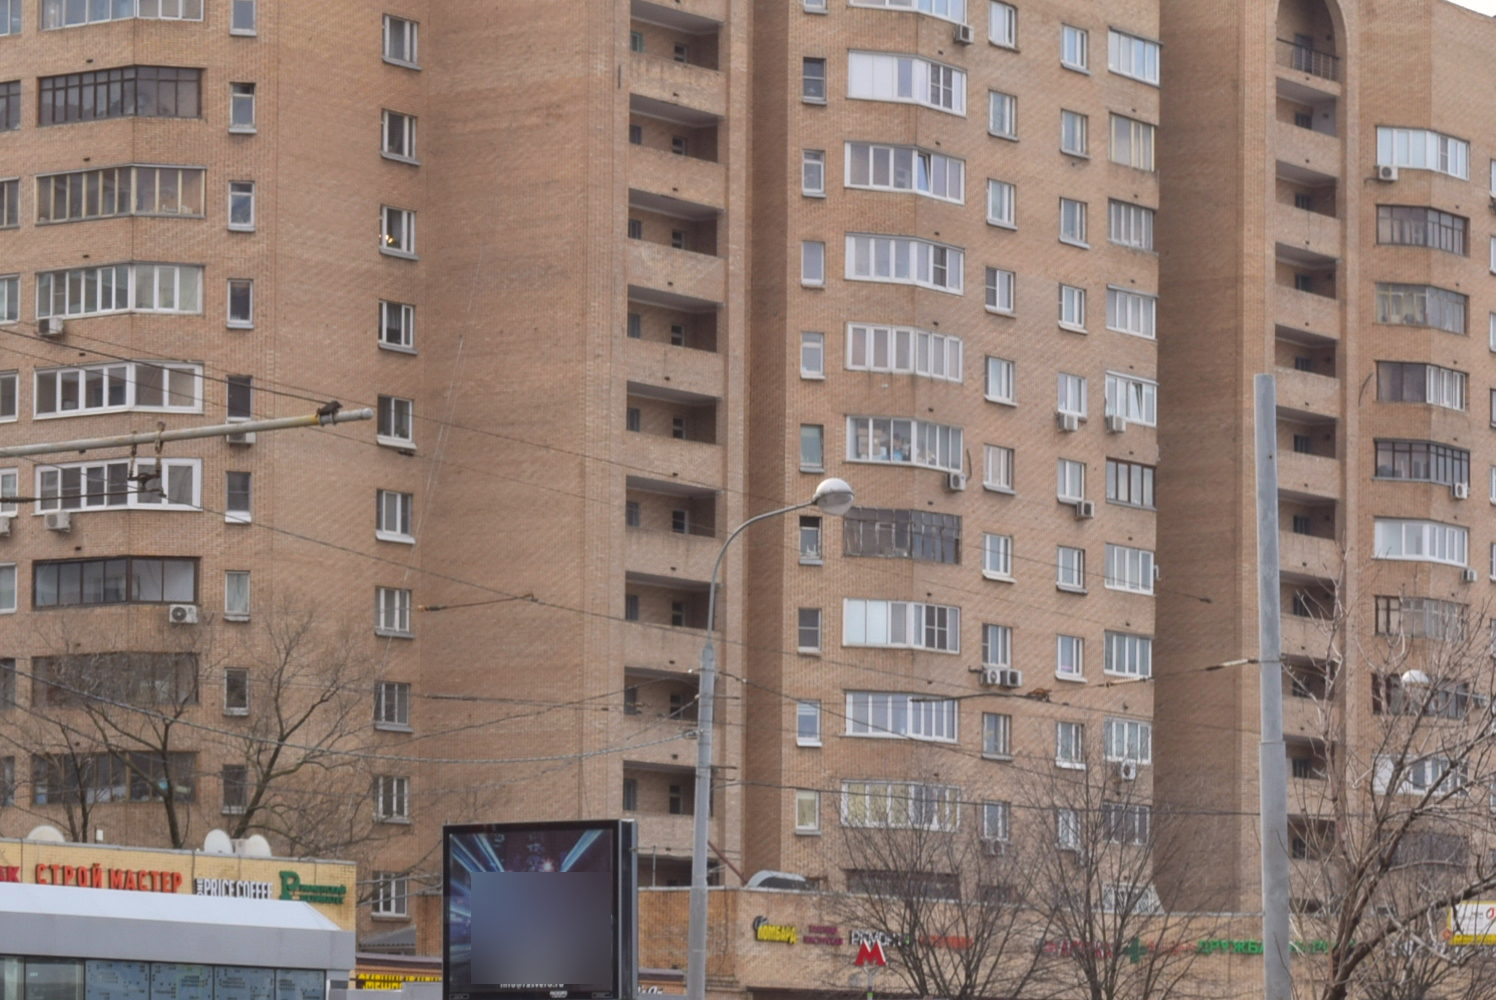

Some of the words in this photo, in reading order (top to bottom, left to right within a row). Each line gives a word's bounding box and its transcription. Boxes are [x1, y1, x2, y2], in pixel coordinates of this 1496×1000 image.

[36, 863, 103, 888] СТРОЙ
[108, 868, 182, 893] МАСТЕР
[204, 878, 235, 896] PRICE
[853, 938, 887, 967] М
